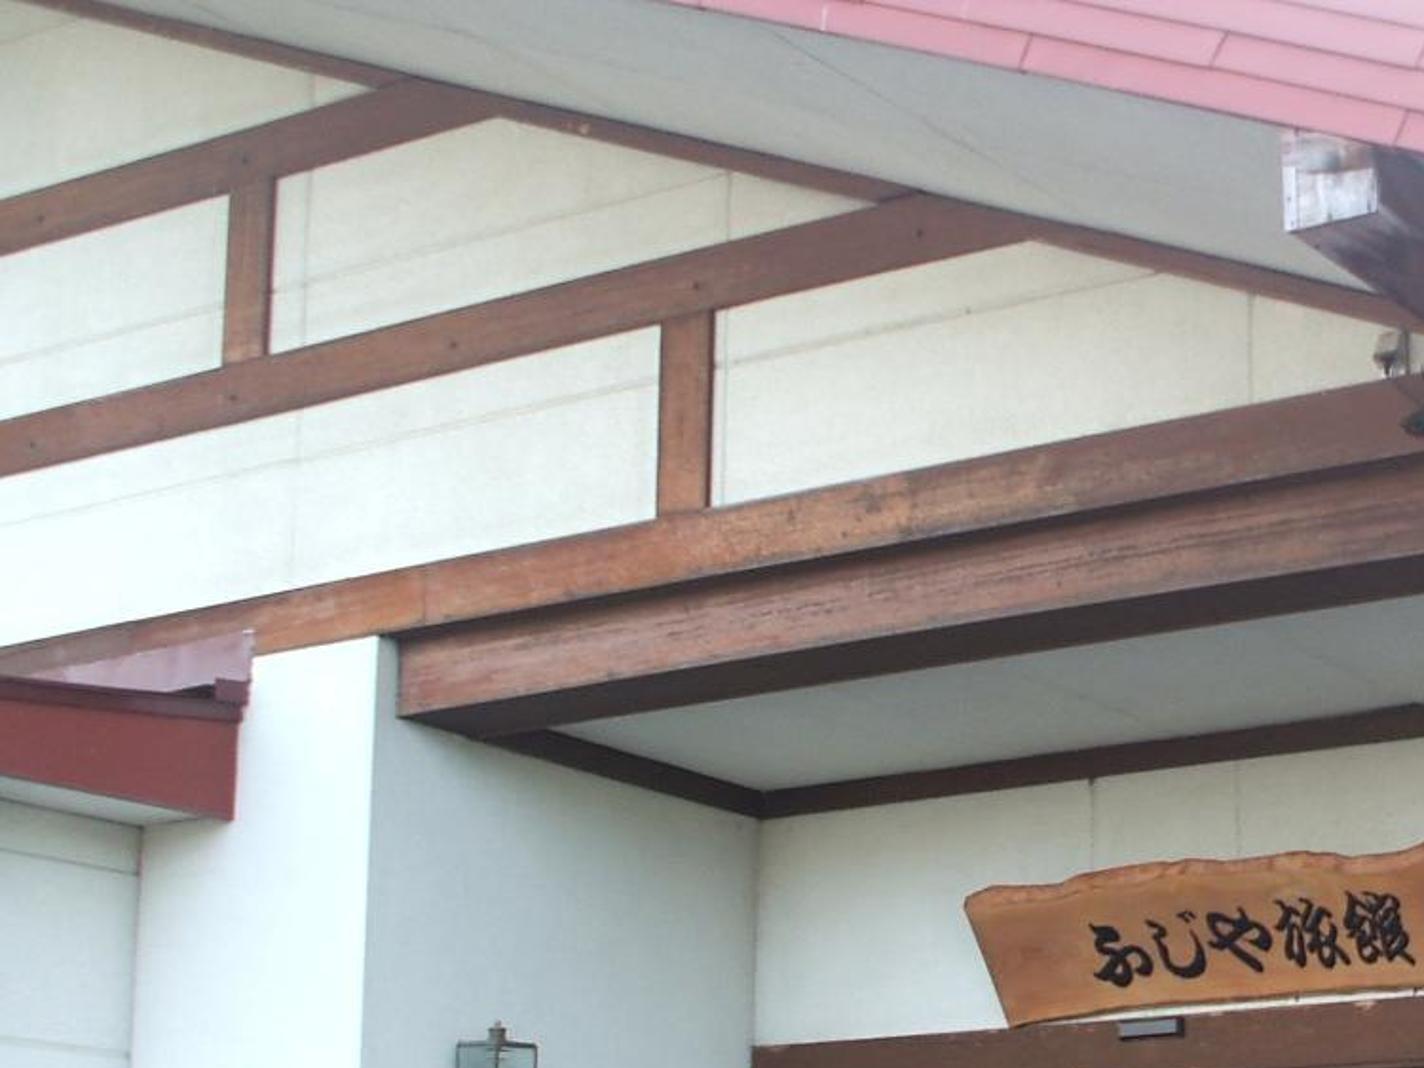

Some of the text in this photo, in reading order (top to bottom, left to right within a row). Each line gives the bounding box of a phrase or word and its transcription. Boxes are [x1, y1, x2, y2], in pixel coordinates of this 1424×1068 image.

[1089, 890, 1416, 988] ふじや旅館
